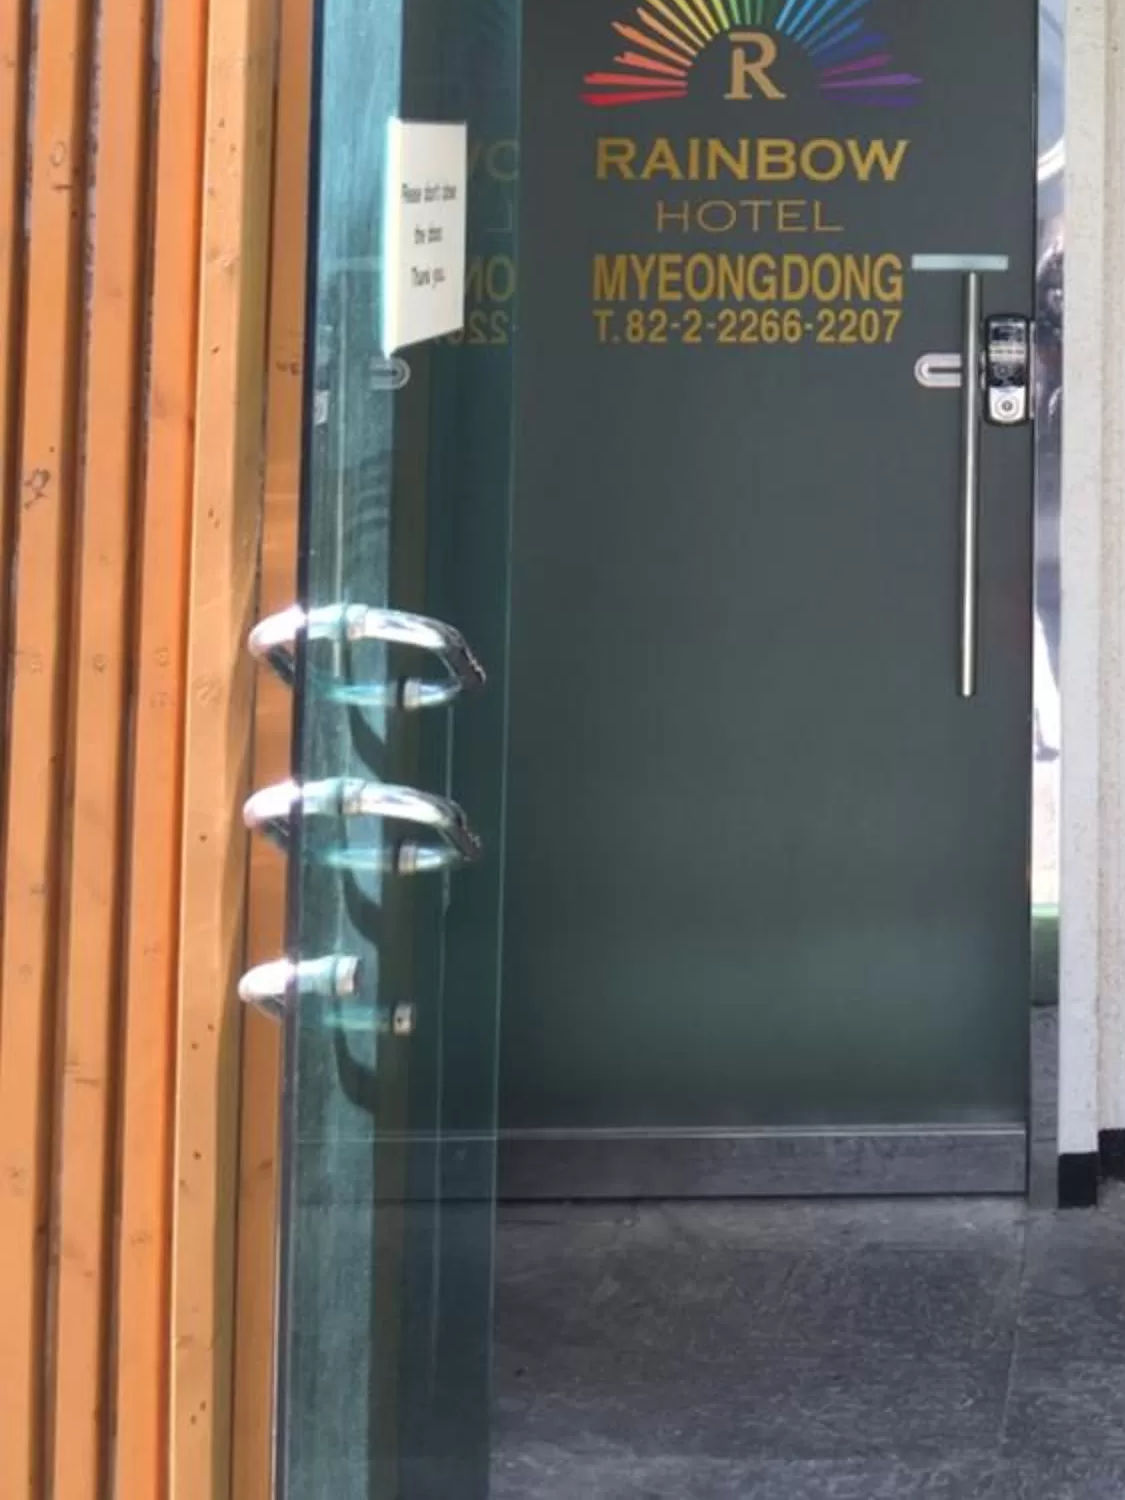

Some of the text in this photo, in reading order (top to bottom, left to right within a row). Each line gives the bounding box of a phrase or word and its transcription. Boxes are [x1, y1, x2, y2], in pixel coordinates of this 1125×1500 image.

[723, 30, 787, 100] R
[595, 137, 912, 181] RAINBOW
[655, 200, 844, 232] HOTEL
[592, 253, 904, 302] MYEONGDONG
